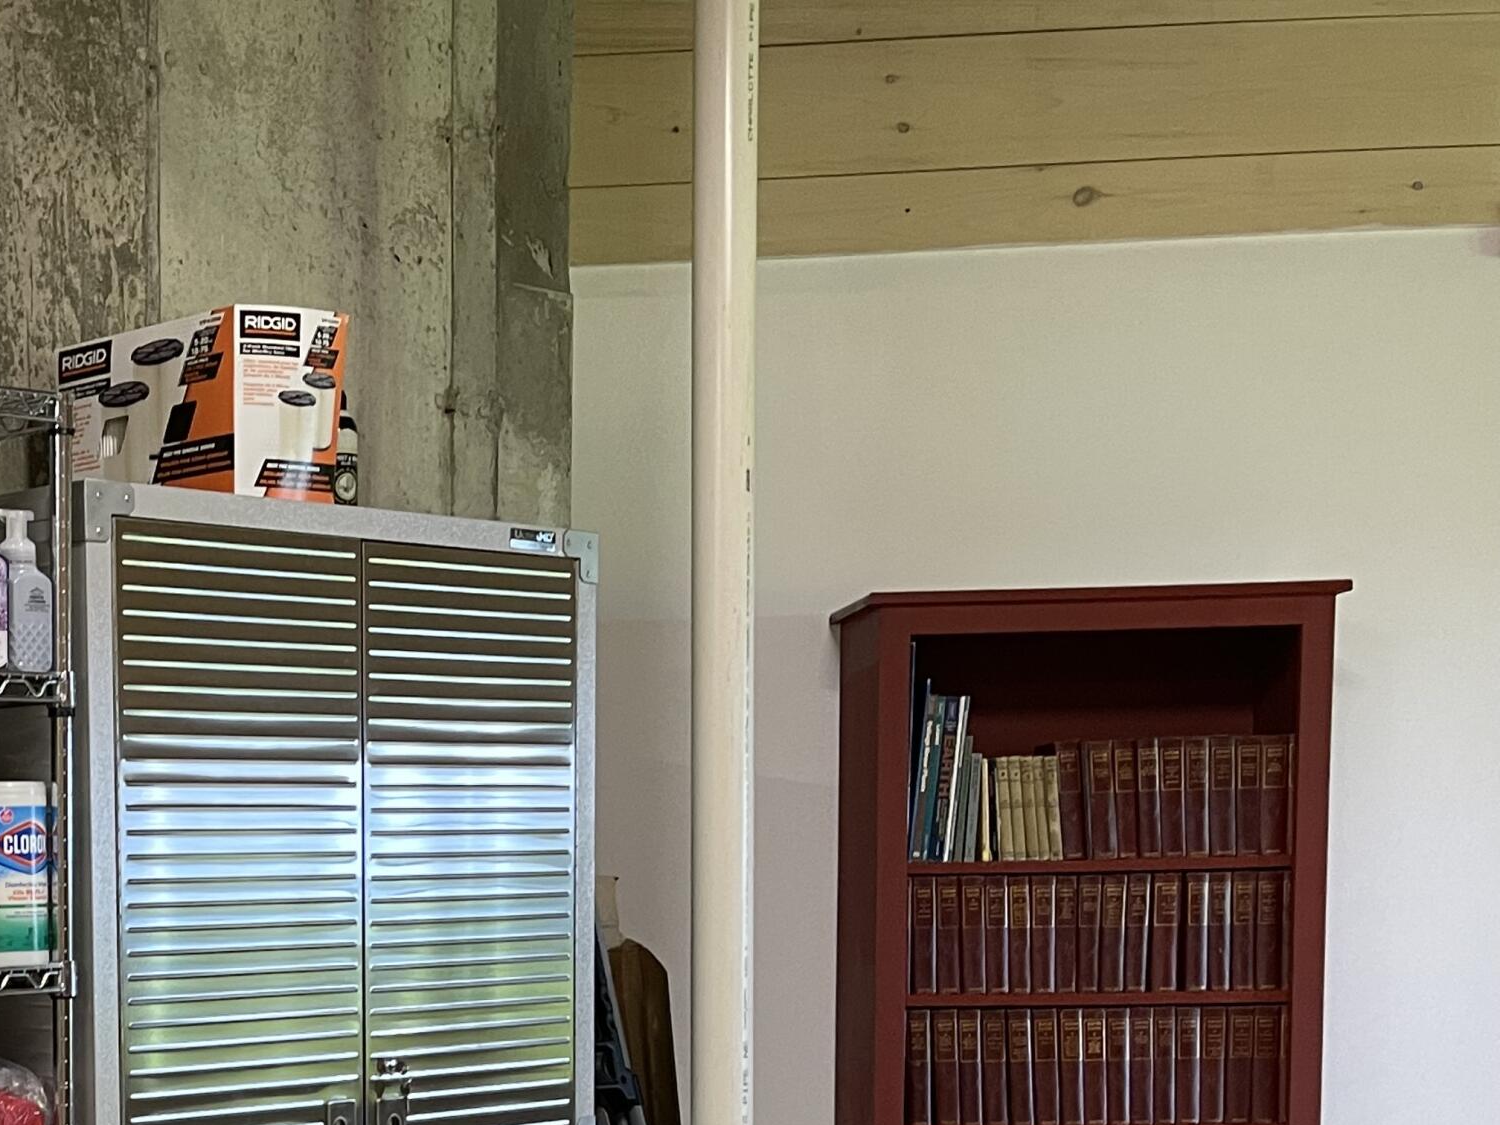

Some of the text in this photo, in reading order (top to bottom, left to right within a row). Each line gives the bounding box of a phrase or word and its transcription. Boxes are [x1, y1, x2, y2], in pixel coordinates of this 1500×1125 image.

[244, 315, 297, 331] RIDGID
[62, 348, 107, 372] RIDGID
[3, 834, 46, 855] CLORO
